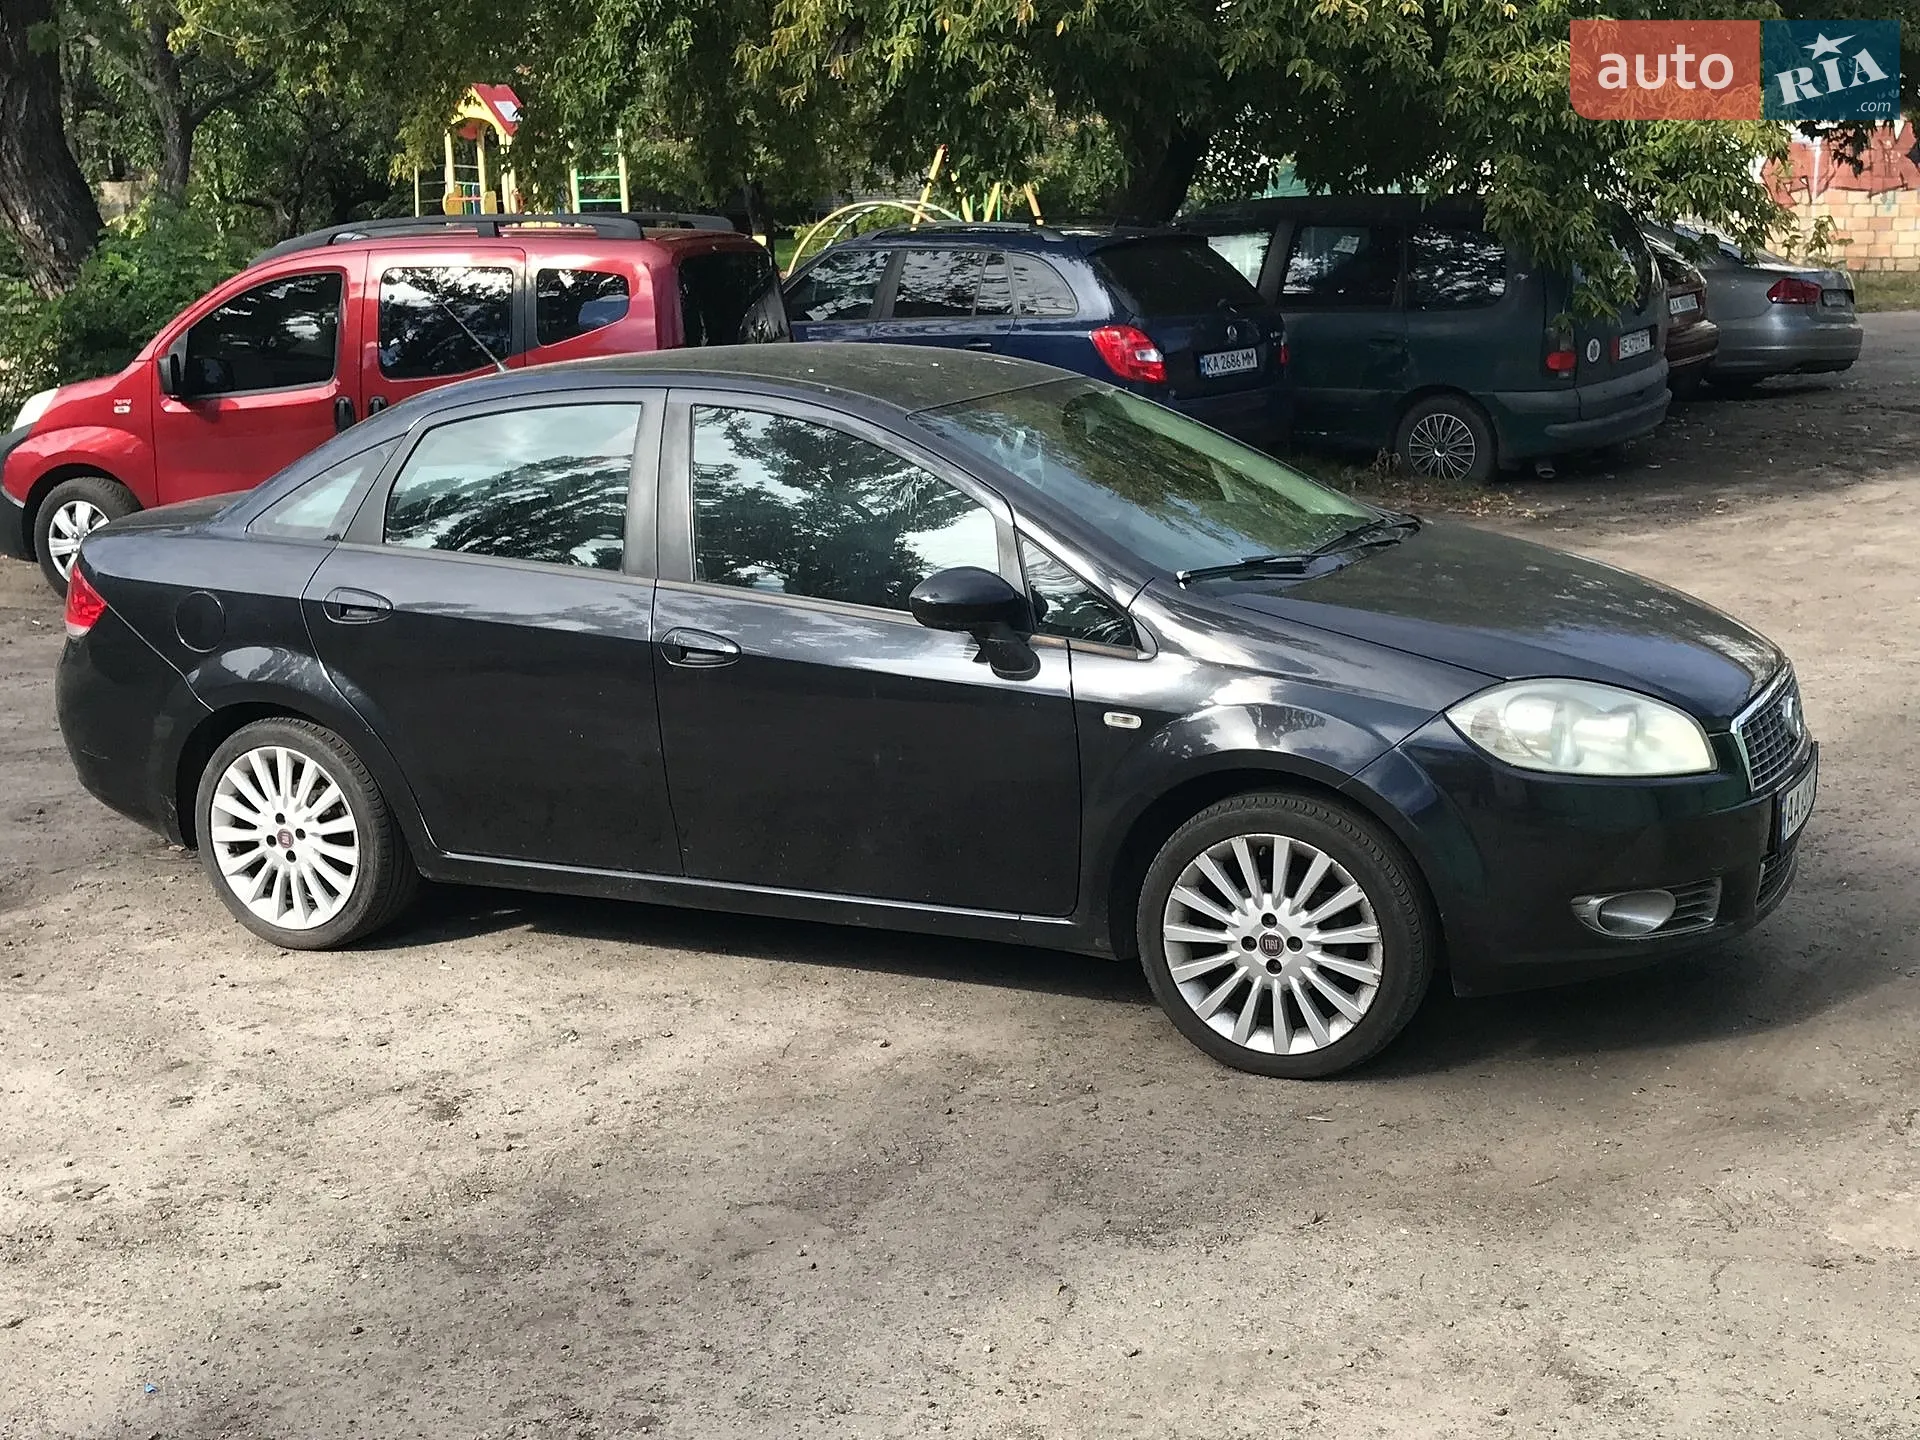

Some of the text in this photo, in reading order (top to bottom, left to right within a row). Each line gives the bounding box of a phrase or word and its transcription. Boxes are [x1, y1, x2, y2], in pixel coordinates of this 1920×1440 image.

[1207, 350, 1255, 372] KA 2686 MM
